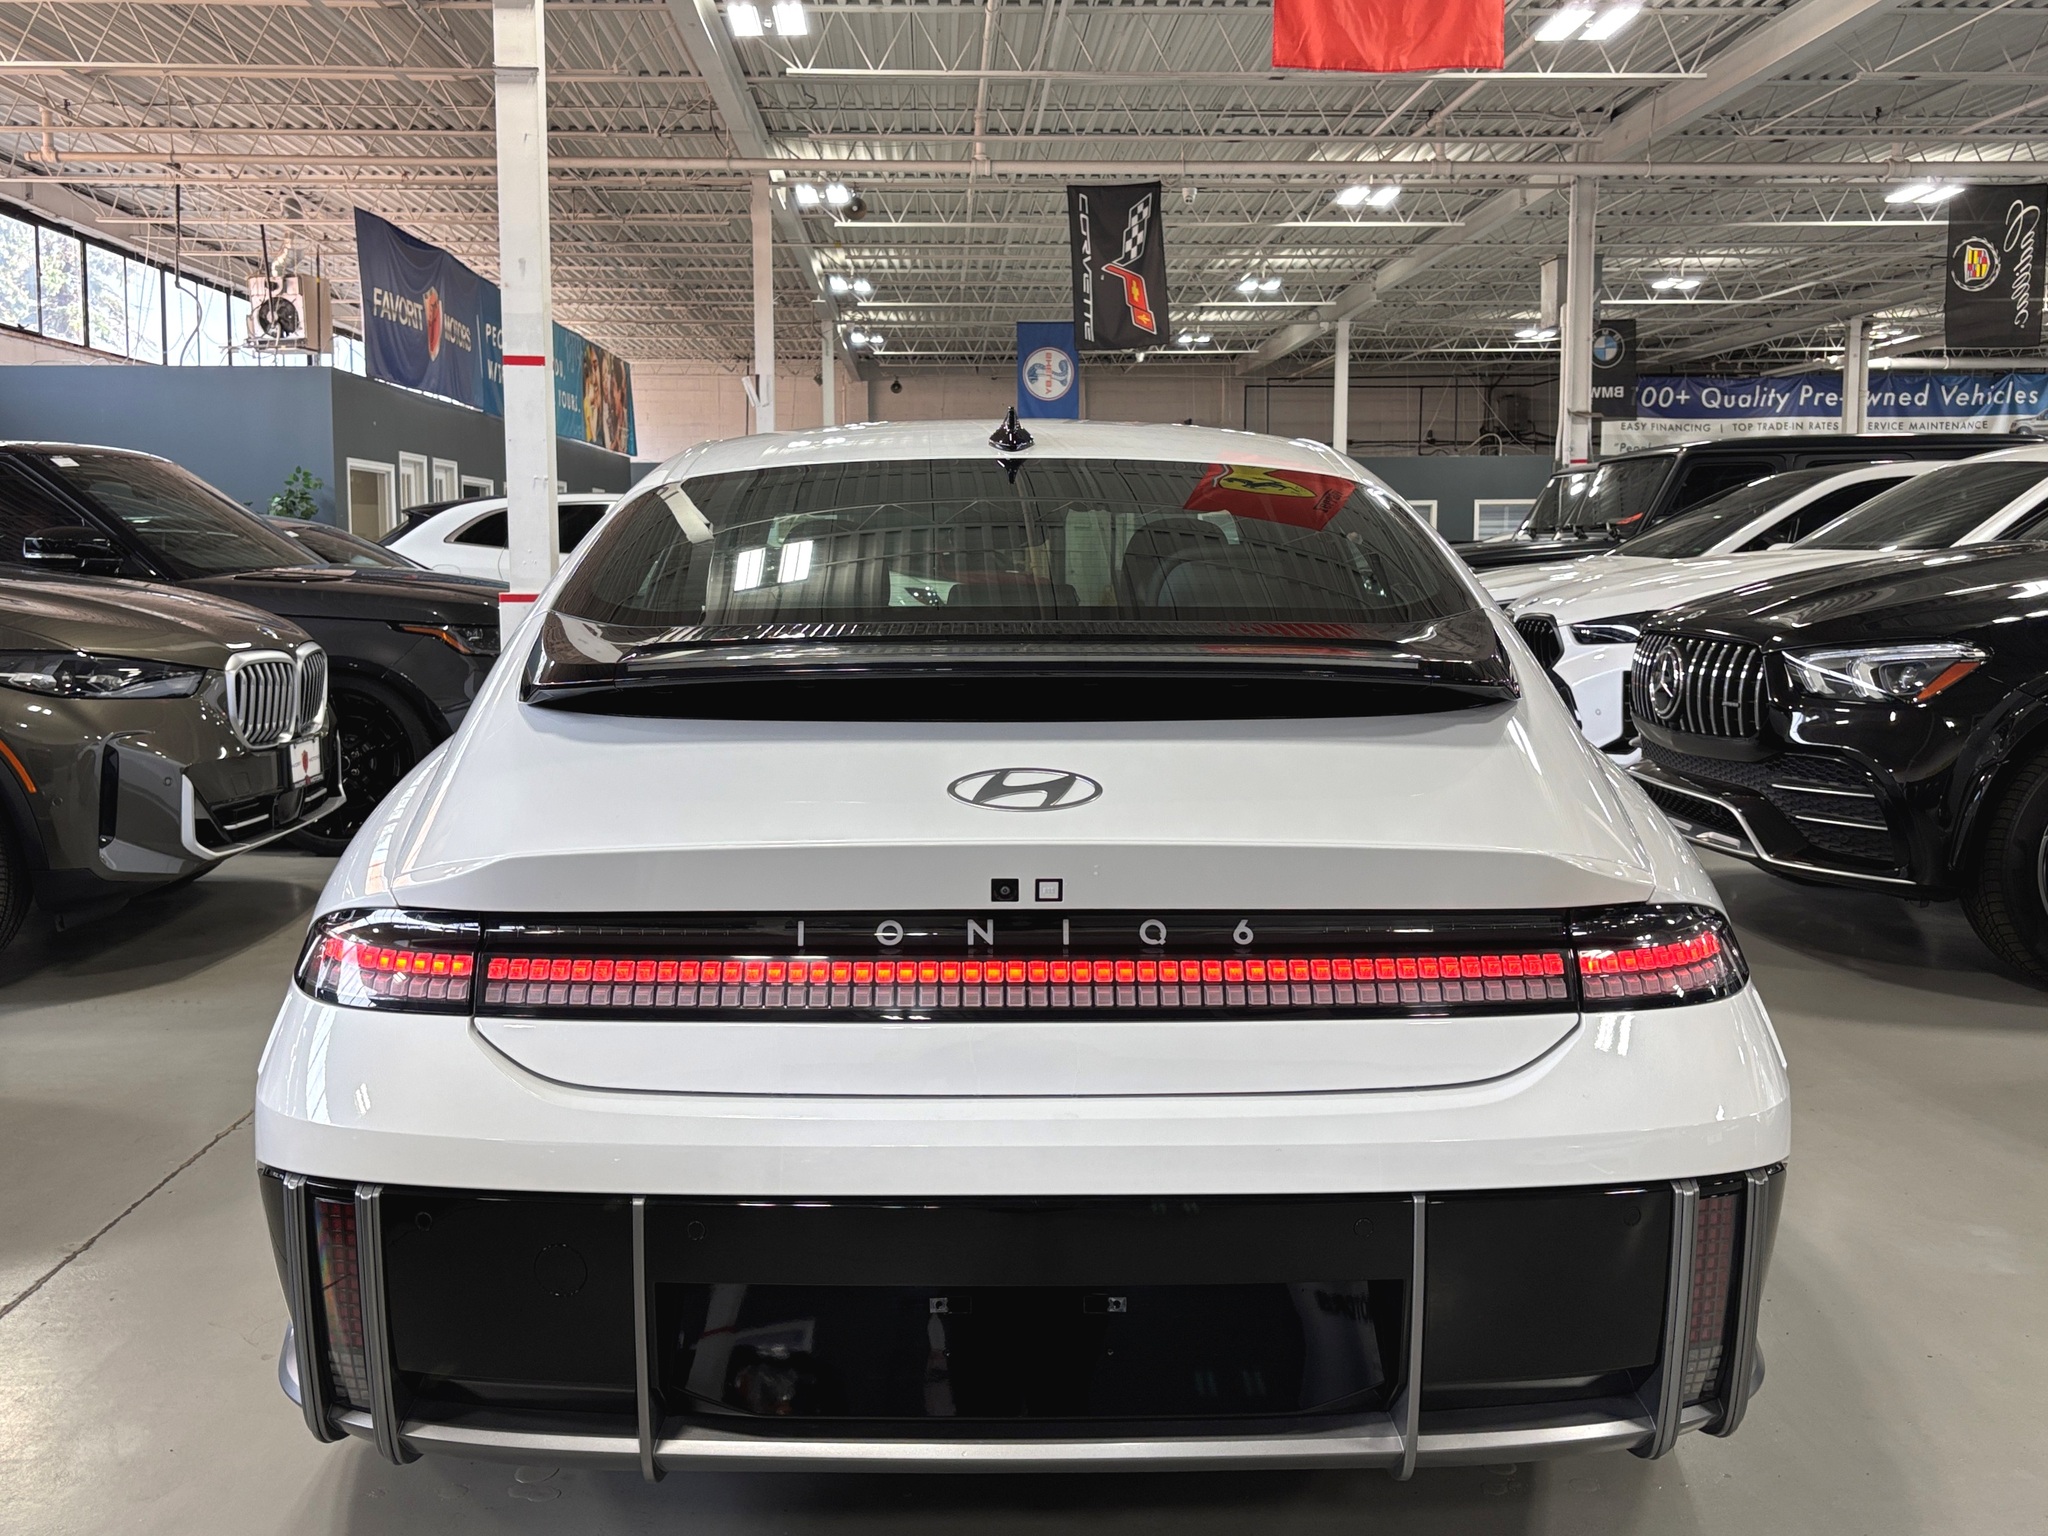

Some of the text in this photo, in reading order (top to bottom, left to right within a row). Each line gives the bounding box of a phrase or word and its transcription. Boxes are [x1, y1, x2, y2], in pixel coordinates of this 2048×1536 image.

[1078, 192, 1095, 343] CORVETTE
[373, 287, 472, 352] FAVORIT MOTORS
[1701, 384, 1790, 413] Quality
[1941, 381, 2039, 406] Vehicles
[1620, 420, 1989, 433] EASY FINANCING TOP TRADE-IN RATES ERVICE MAINTENANCE
[797, 918, 1255, 947] IONIQ 6
